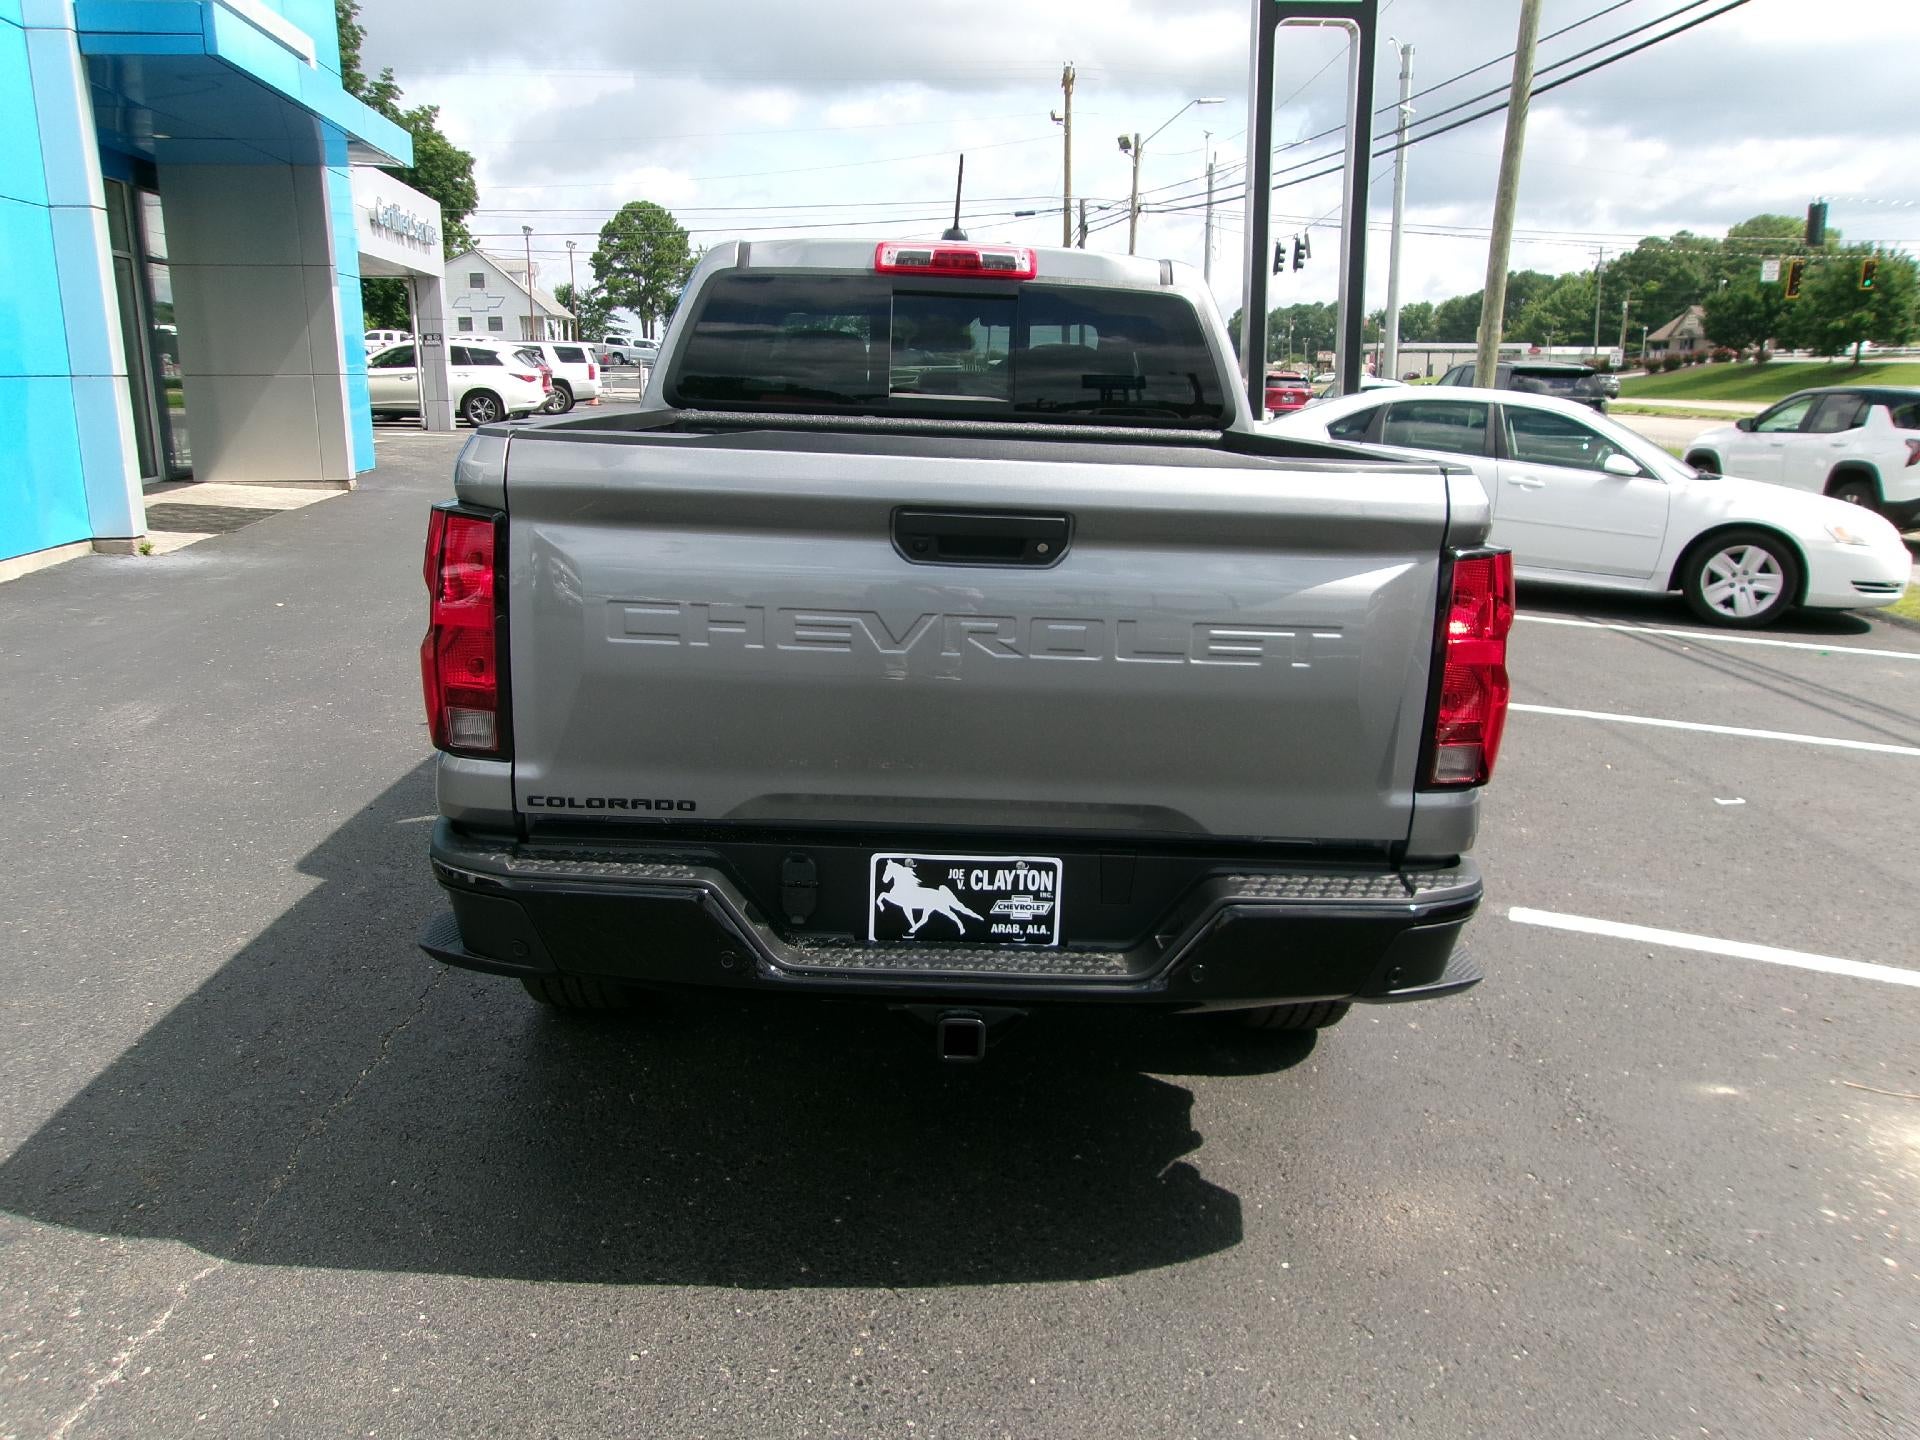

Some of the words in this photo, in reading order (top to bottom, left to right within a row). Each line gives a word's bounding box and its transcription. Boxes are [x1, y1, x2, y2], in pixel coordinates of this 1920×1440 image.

[606, 600, 1345, 668] CHEVROLET
[526, 795, 697, 811] COLORADO
[948, 869, 965, 880] JOE
[970, 869, 1054, 891] CLAYTON
[957, 879, 966, 890] V.
[997, 903, 1046, 911] CHEVROLET
[990, 924, 1023, 935] ARAB,
[1027, 925, 1051, 935] ALA.
